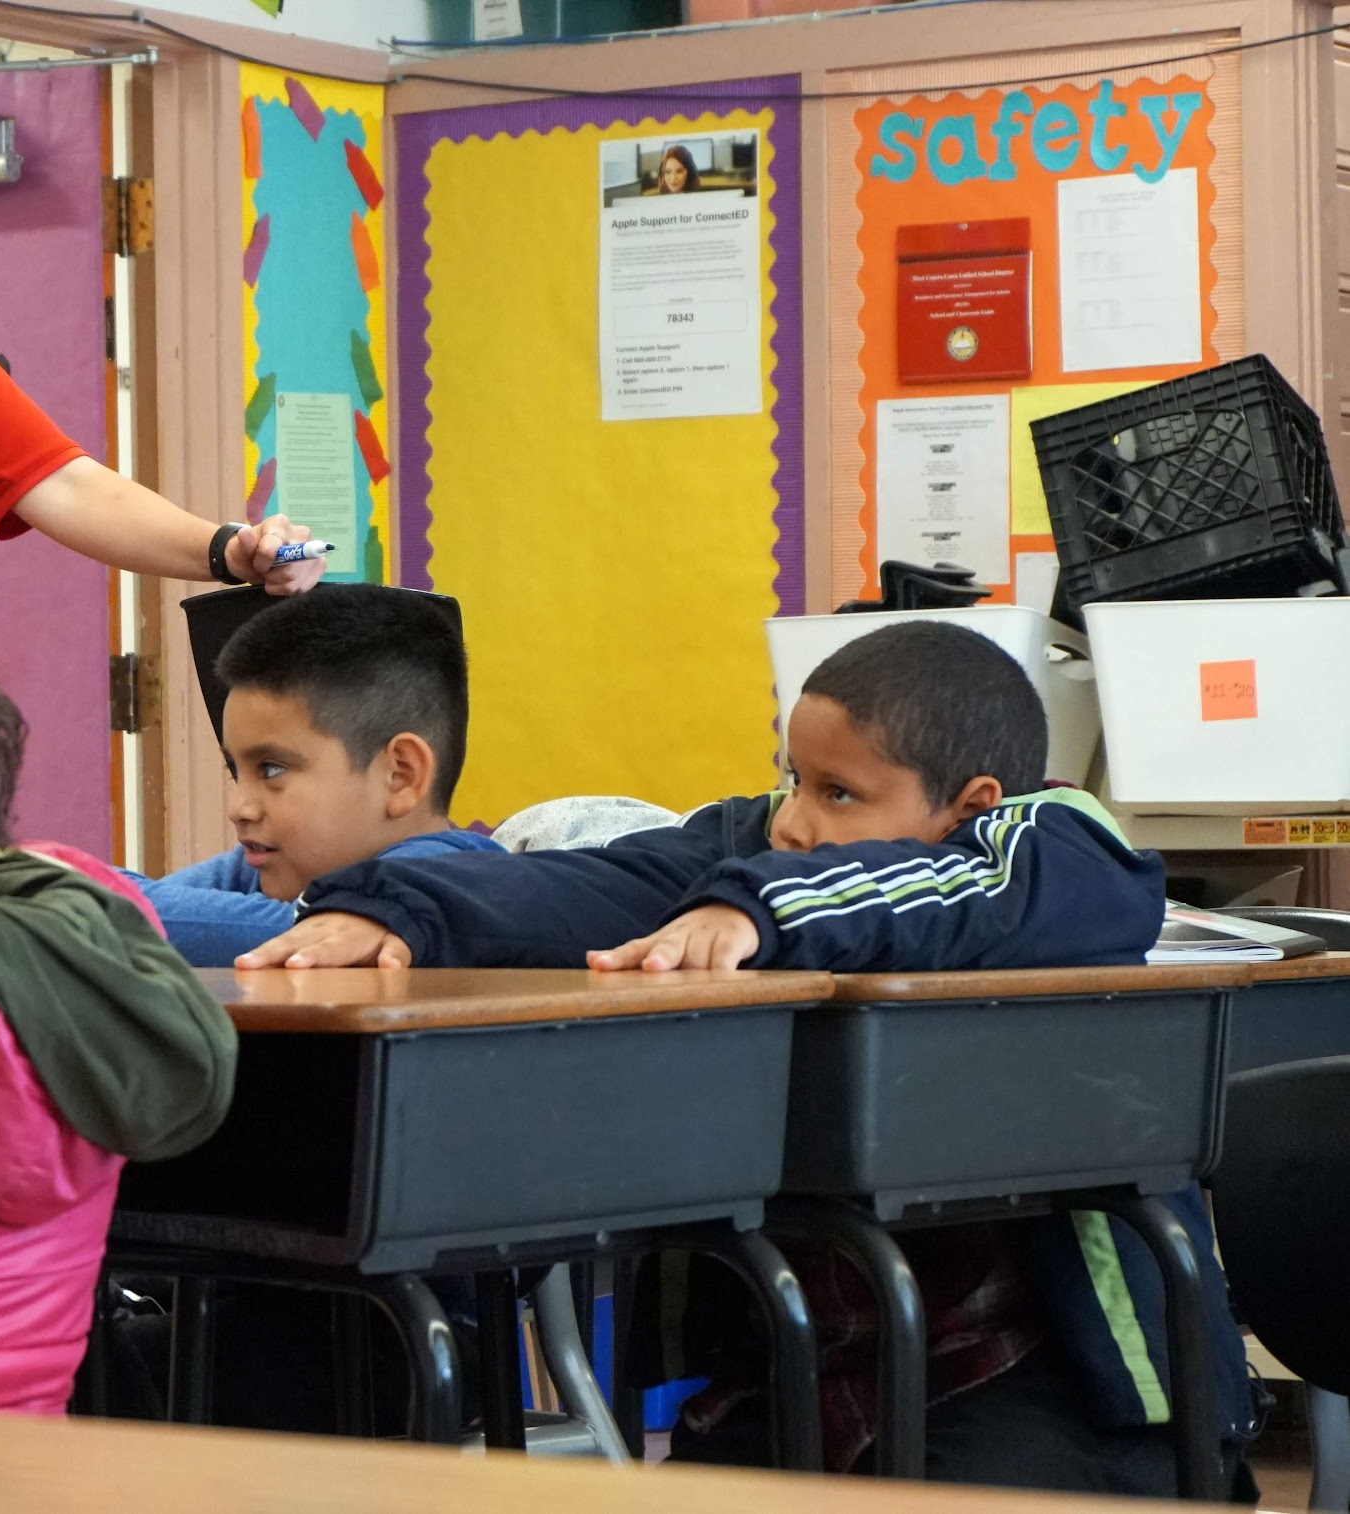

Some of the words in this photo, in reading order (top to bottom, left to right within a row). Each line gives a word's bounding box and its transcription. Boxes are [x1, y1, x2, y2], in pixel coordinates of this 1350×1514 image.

[870, 79, 1202, 186] safety
[612, 219, 638, 230] Apple
[640, 215, 678, 228] Support
[679, 214, 693, 224] for
[695, 209, 749, 223] ConnectED
[667, 313, 694, 323] 78343
